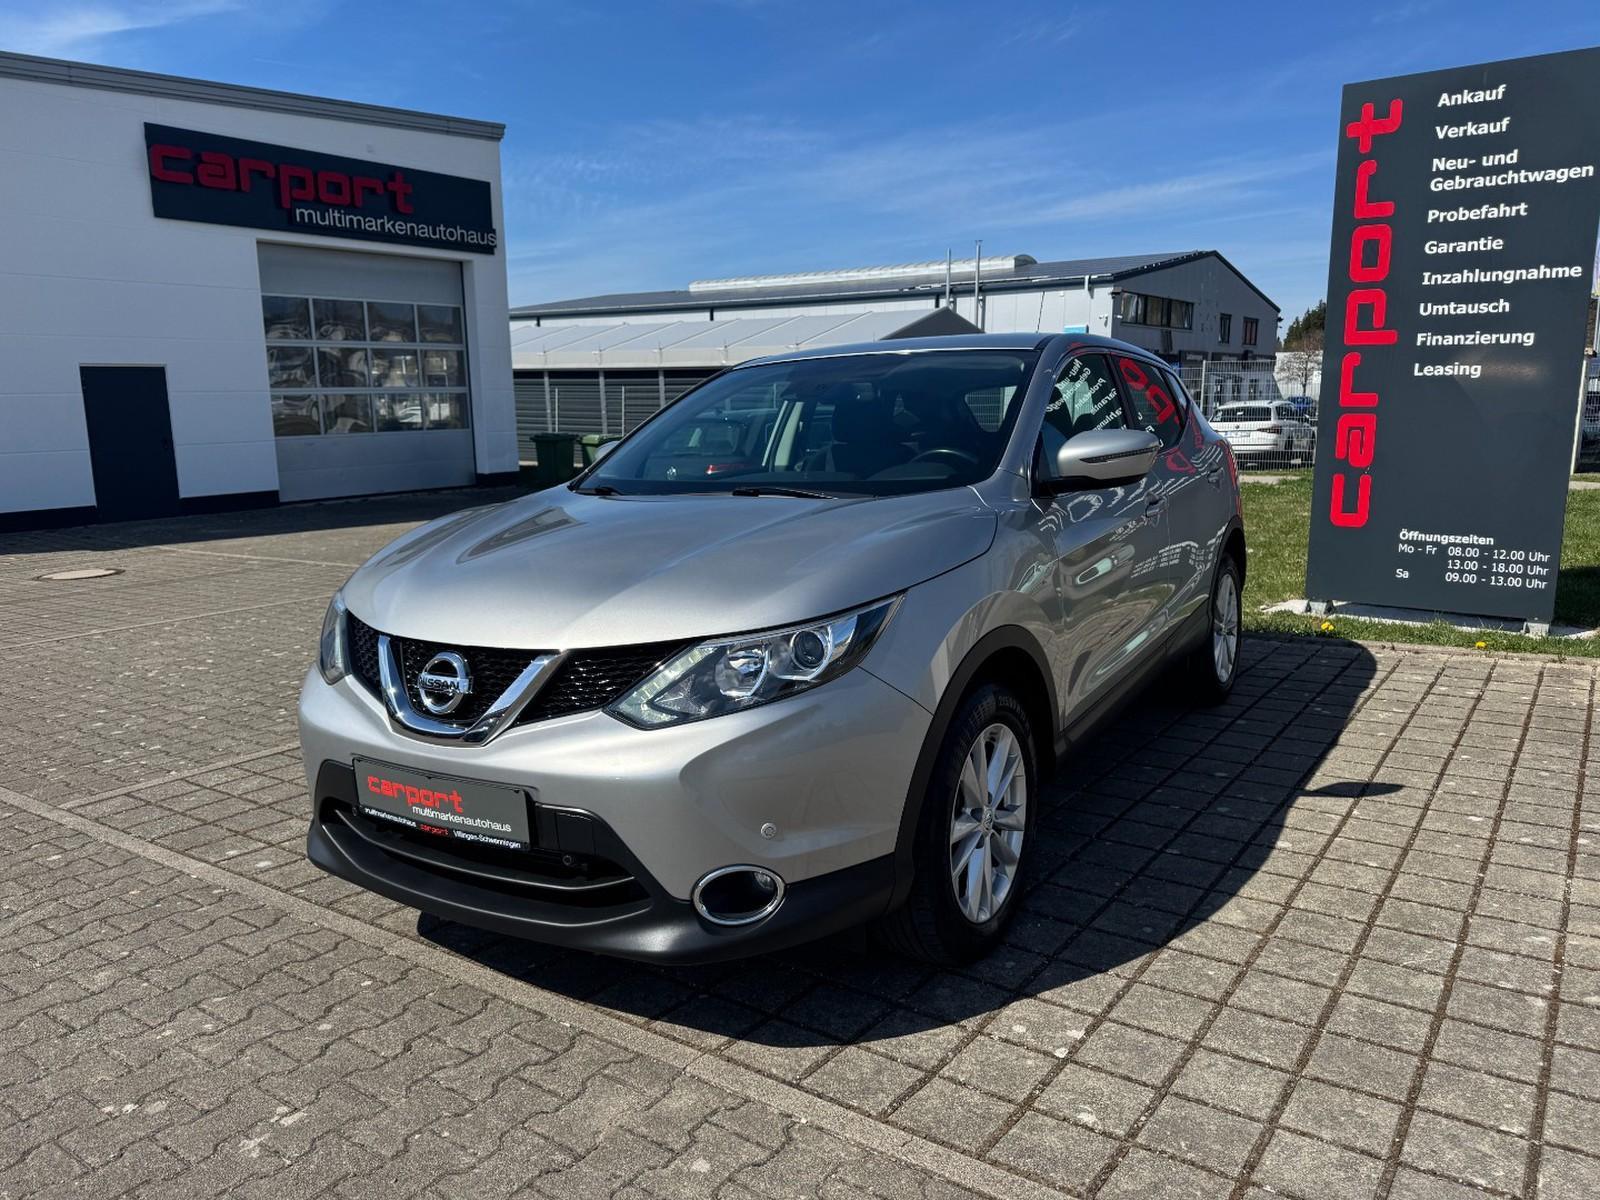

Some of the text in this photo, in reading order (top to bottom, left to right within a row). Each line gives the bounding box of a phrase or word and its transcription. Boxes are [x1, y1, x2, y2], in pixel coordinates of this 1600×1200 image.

[1437, 84, 1506, 107] Ankauf
[1436, 117, 1511, 139] Verkauf
[1432, 149, 1518, 171] Neu- und
[150, 143, 413, 213] carport
[1430, 164, 1595, 191] Gebrauchtwagen
[1427, 202, 1528, 223] Probefahrt
[296, 206, 497, 247] multimarkenautohaus
[1424, 236, 1504, 255] Garantie
[1422, 264, 1583, 286] Inzahlungnahme
[1330, 98, 1403, 527] carport
[1419, 299, 1510, 316] Umtausch
[1416, 330, 1535, 347] Finanzierung
[1413, 362, 1482, 378] Leasing
[1400, 528, 1494, 545] Öffnungszeiten
[1398, 543, 1414, 554] Mo
[1426, 545, 1437, 555] Fr
[1448, 546, 1479, 558] 08.00
[1493, 550, 1525, 561] 12.00
[1529, 552, 1550, 562] Uhr
[1447, 559, 1478, 571] 13.00
[1492, 563, 1523, 574] 18.00
[1527, 565, 1549, 576] Uhr
[1396, 568, 1409, 579] Sa
[1445, 573, 1477, 584] 09.00
[1490, 576, 1521, 588] 13.00
[1526, 578, 1547, 589] Uhr
[420, 676, 460, 690] NISSAN
[367, 775, 463, 813] carport
[412, 805, 512, 832] multimarkenautohaus
